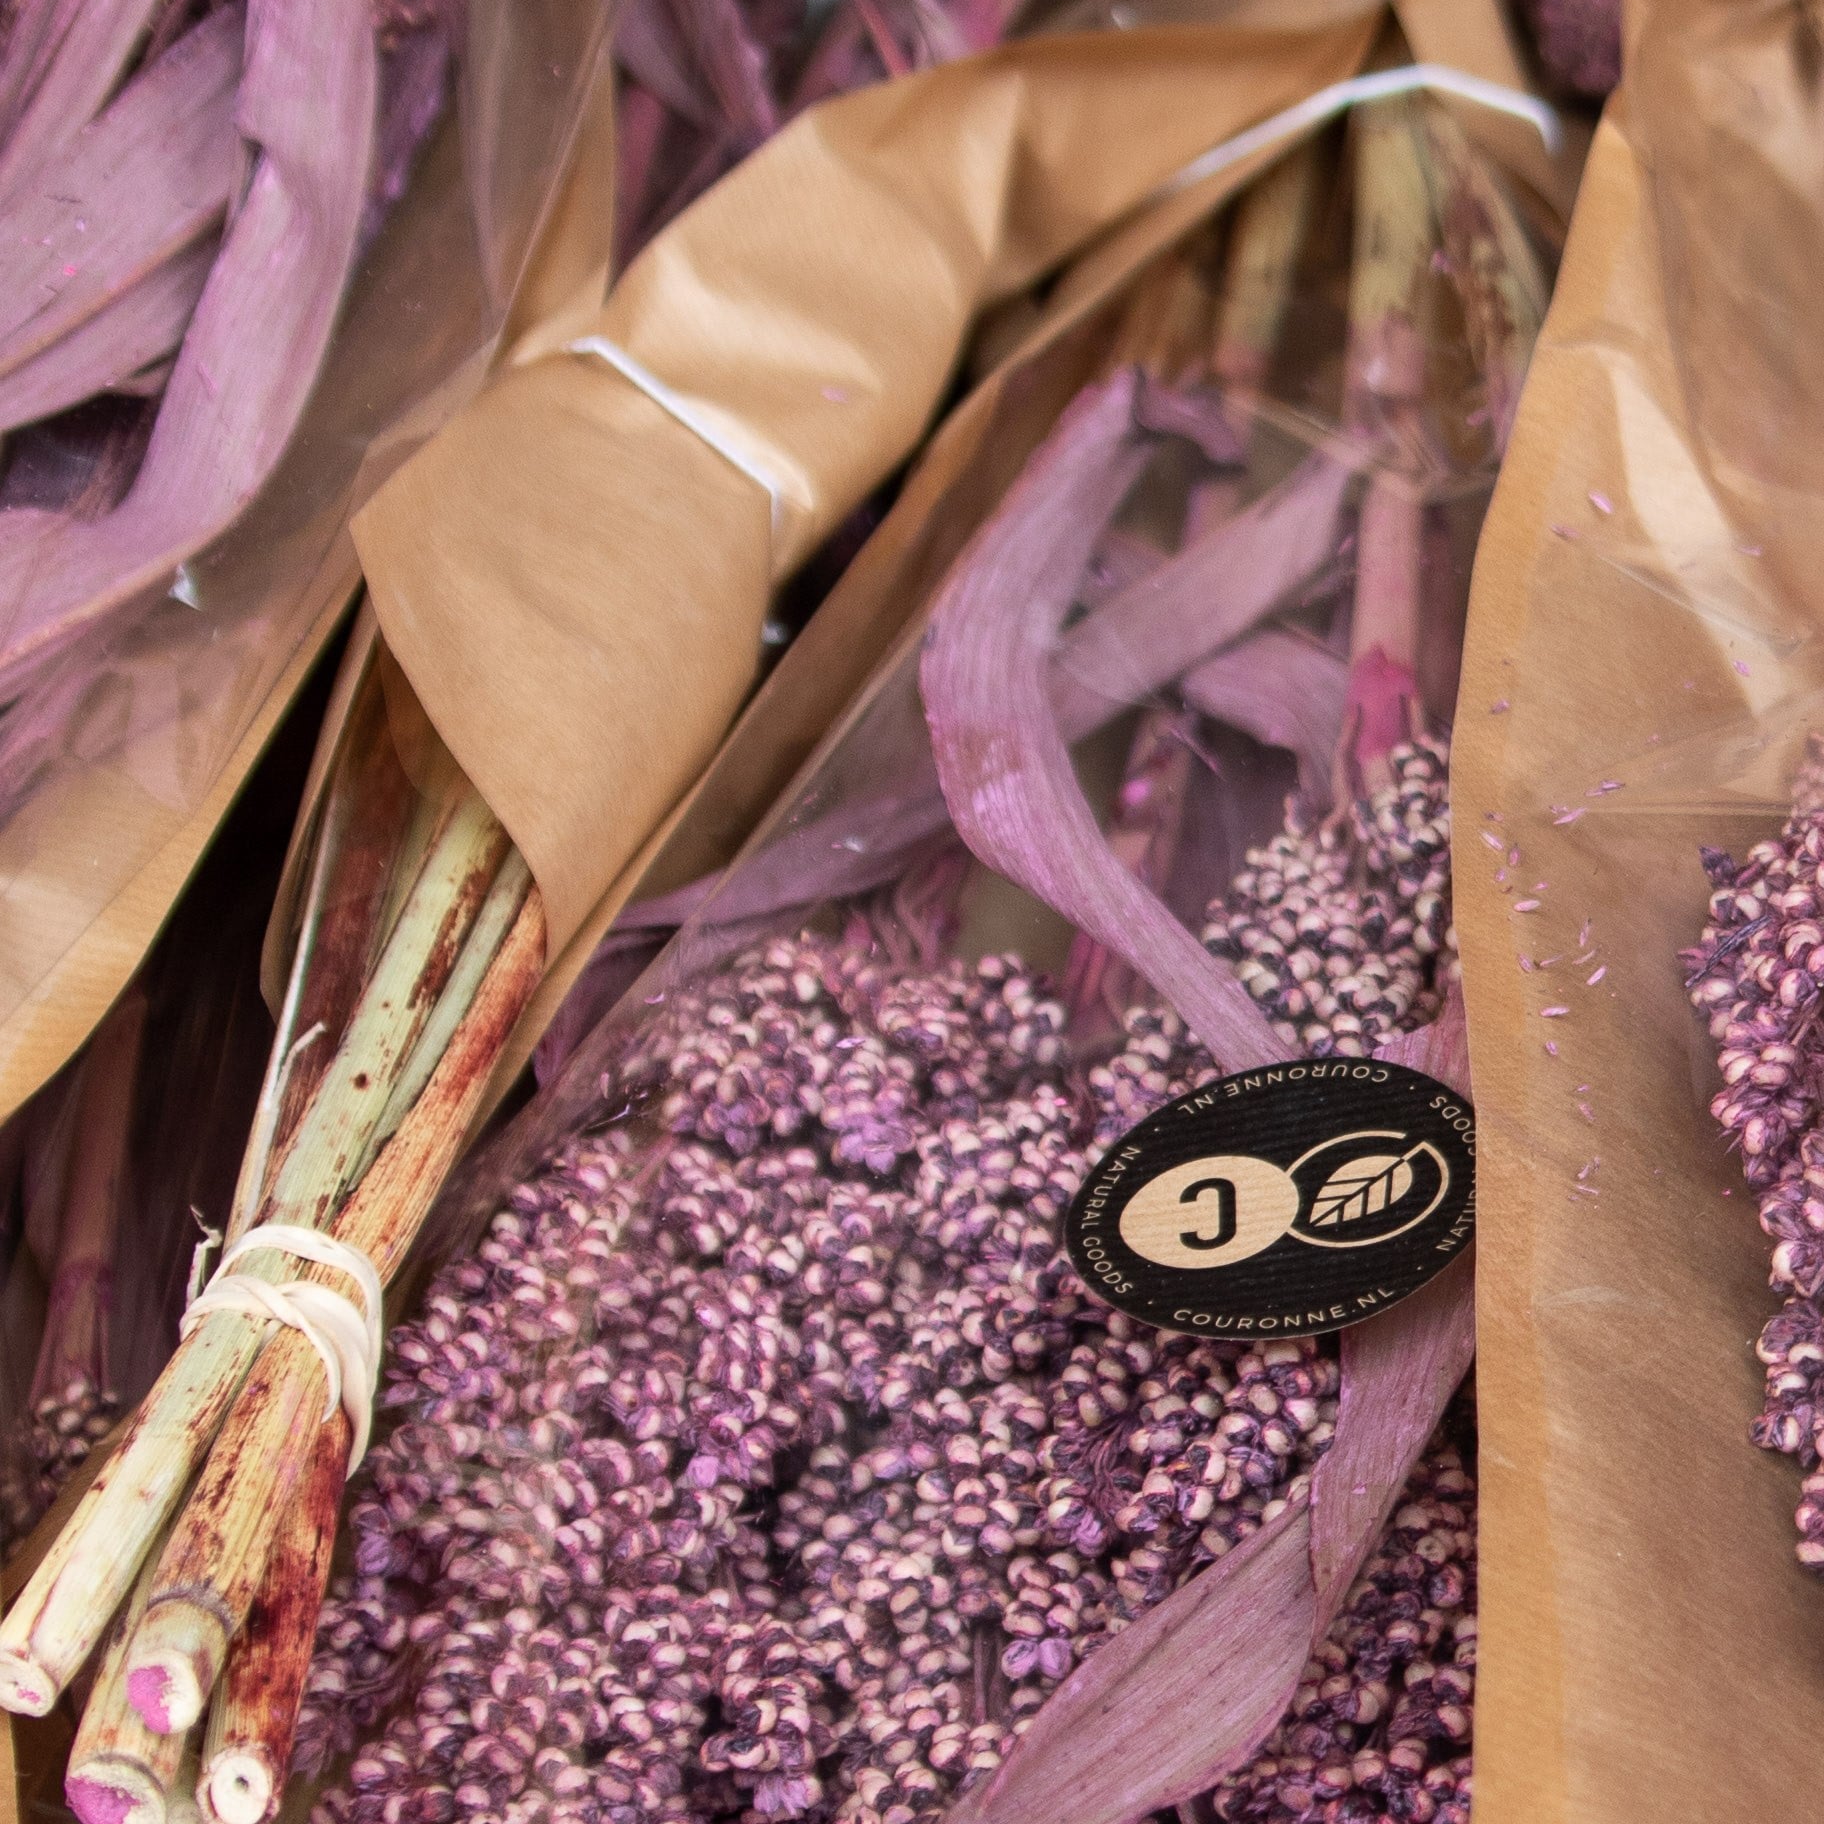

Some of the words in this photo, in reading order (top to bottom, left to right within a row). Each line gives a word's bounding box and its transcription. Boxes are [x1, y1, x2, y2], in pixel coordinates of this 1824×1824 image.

[1177, 1063, 1389, 1116] COURONNE.NL
[1080, 1145, 1142, 1230] NATURAL
[1178, 1176, 1238, 1251] C
[1081, 1236, 1134, 1294] GOODS
[1172, 1287, 1396, 1330] COURONNE.NL
